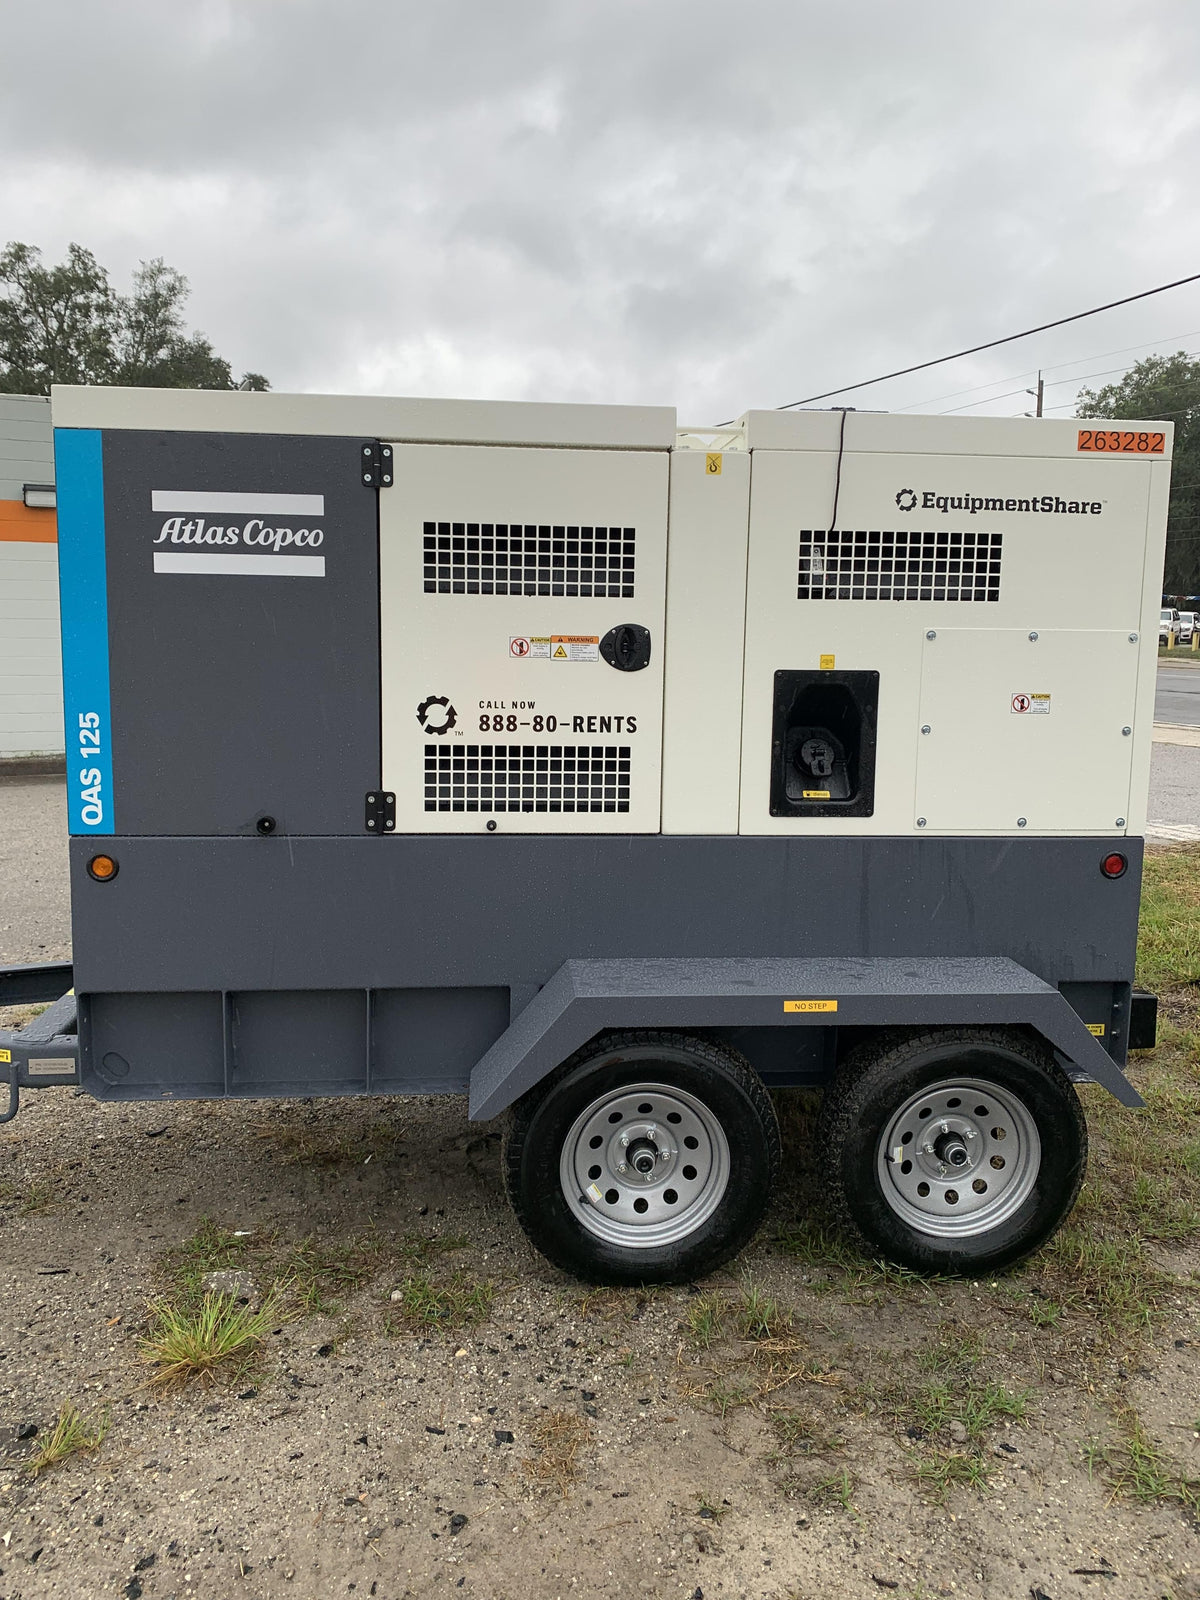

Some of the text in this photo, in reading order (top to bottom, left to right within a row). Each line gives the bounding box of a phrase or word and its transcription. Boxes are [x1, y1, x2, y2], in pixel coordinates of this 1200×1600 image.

[1079, 430, 1164, 452] 263282
[921, 491, 1102, 515] EquipmentShare
[152, 517, 324, 552] Atlas Copco
[478, 700, 536, 710] CALL NOW
[478, 714, 638, 734] 888-80-RENTS
[78, 712, 103, 826] QAS 125
